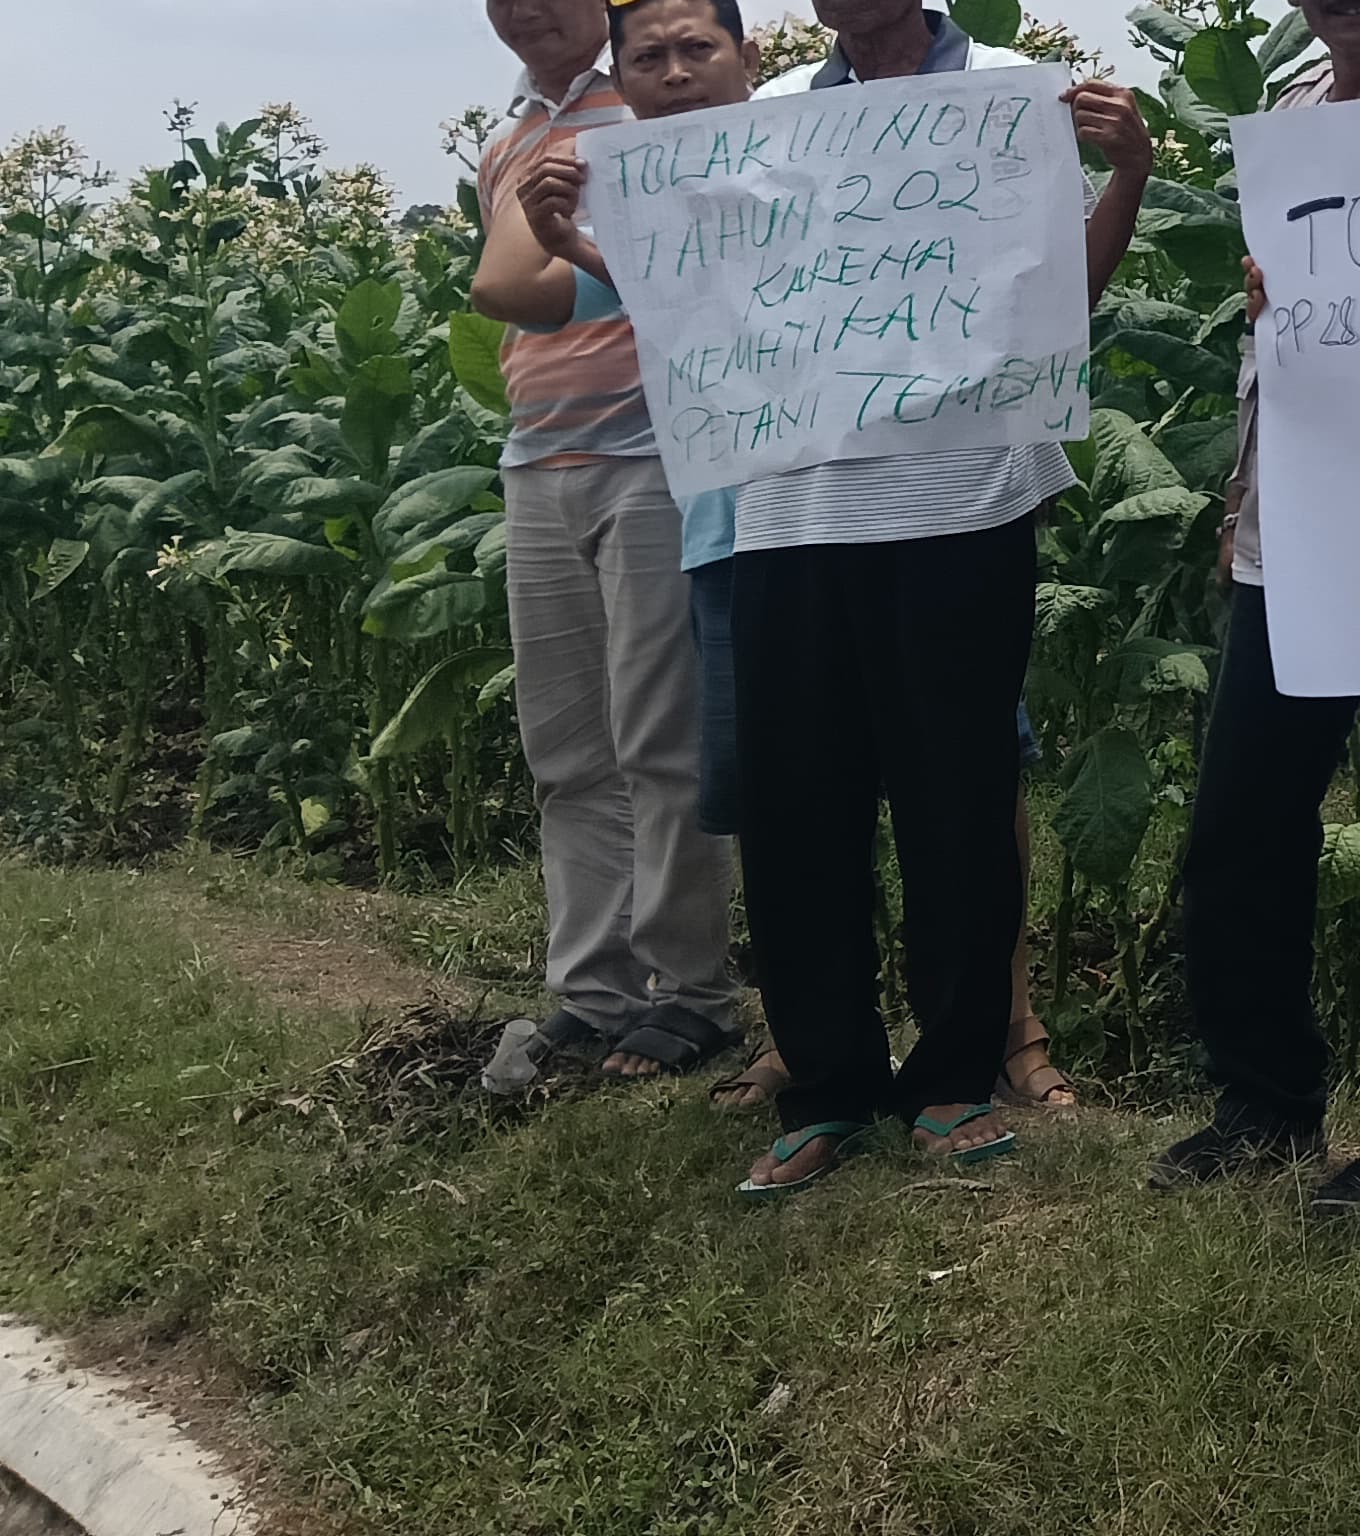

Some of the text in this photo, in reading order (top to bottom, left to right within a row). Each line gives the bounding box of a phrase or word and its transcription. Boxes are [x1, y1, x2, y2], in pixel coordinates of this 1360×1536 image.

[609, 119, 773, 198] TOLAK
[872, 103, 966, 155] NO
[632, 191, 815, 280] TAHUN
[1274, 298, 1313, 366] PP
[672, 391, 820, 462] PETANI
